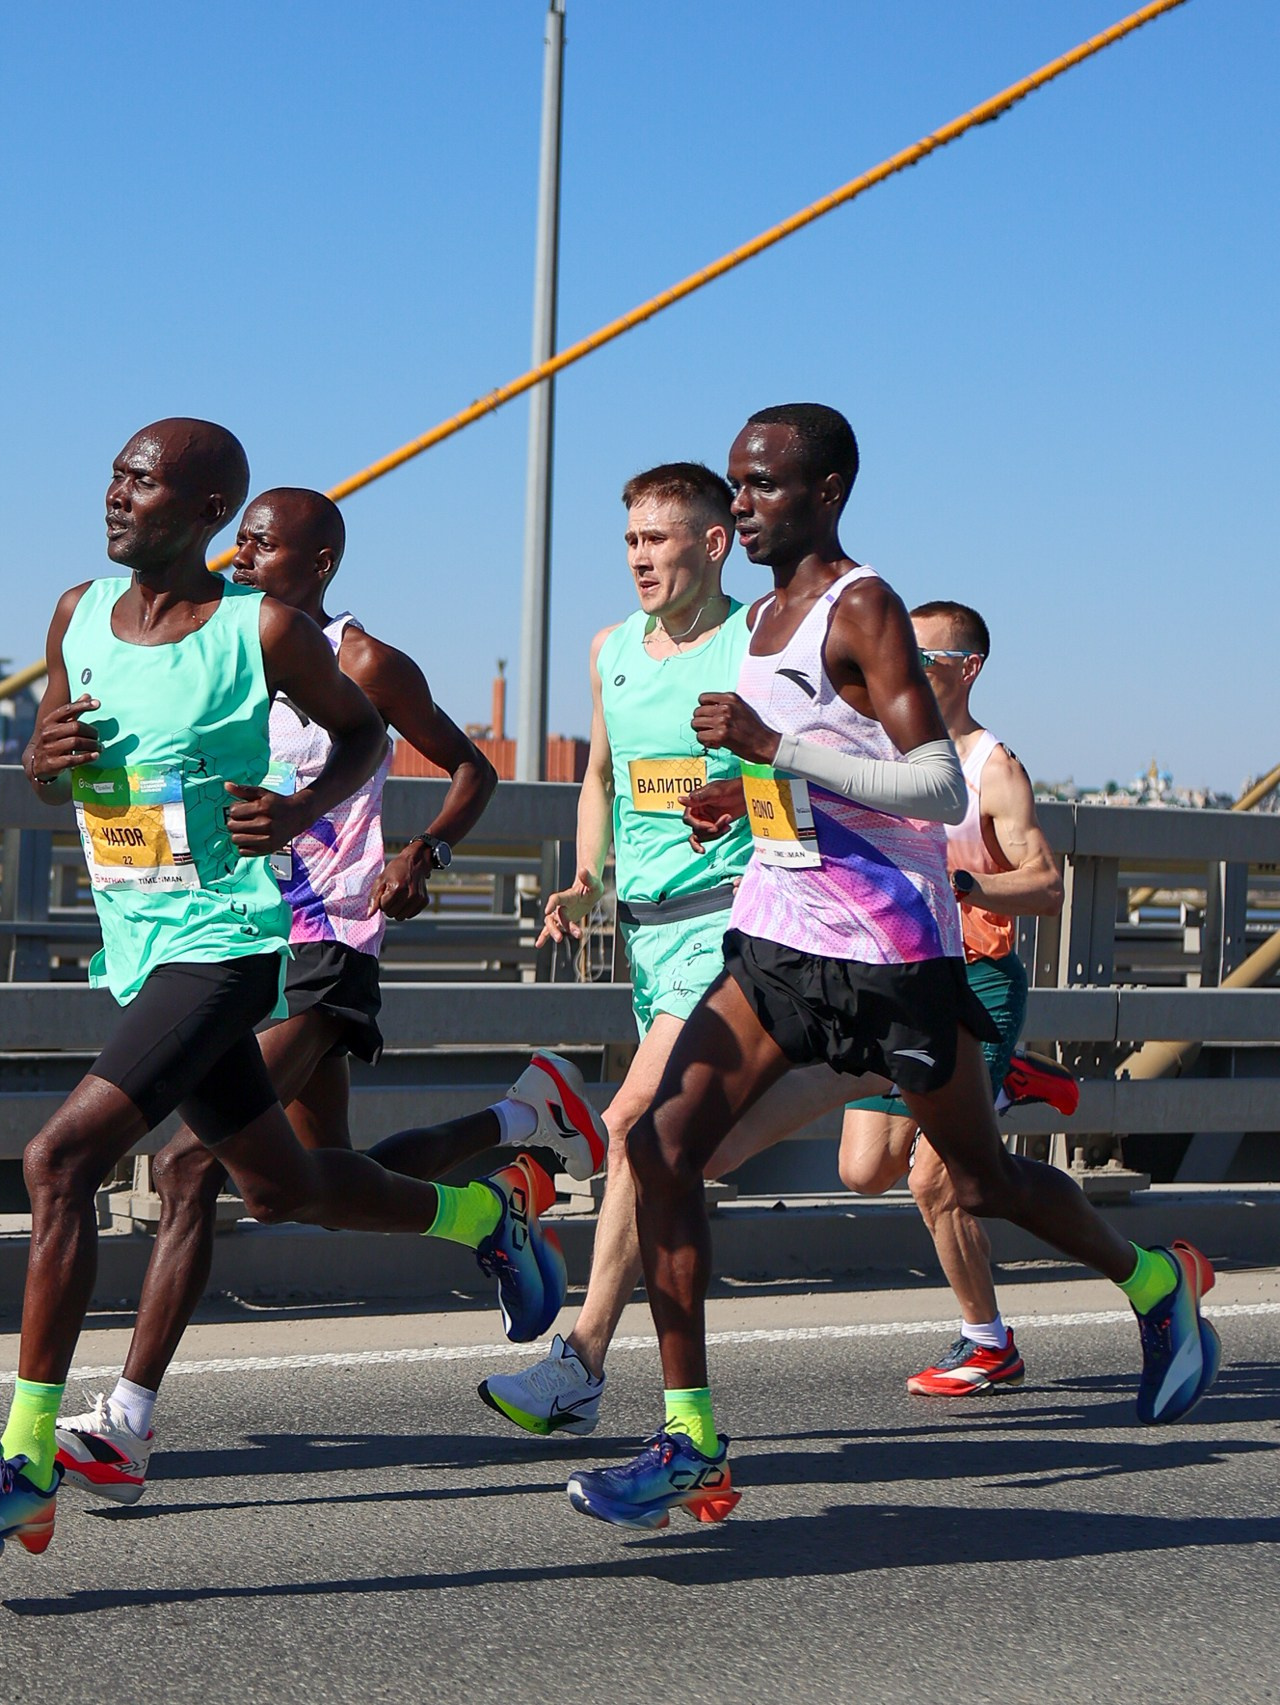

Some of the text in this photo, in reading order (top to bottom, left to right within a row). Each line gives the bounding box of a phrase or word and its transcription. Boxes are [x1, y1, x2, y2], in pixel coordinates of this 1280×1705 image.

[637, 777, 703, 794] ВАЛИТОВ
[666, 801, 675, 809] 37
[751, 798, 775, 820] RONO
[102, 827, 146, 847] YATOR
[122, 855, 134, 865] 22
